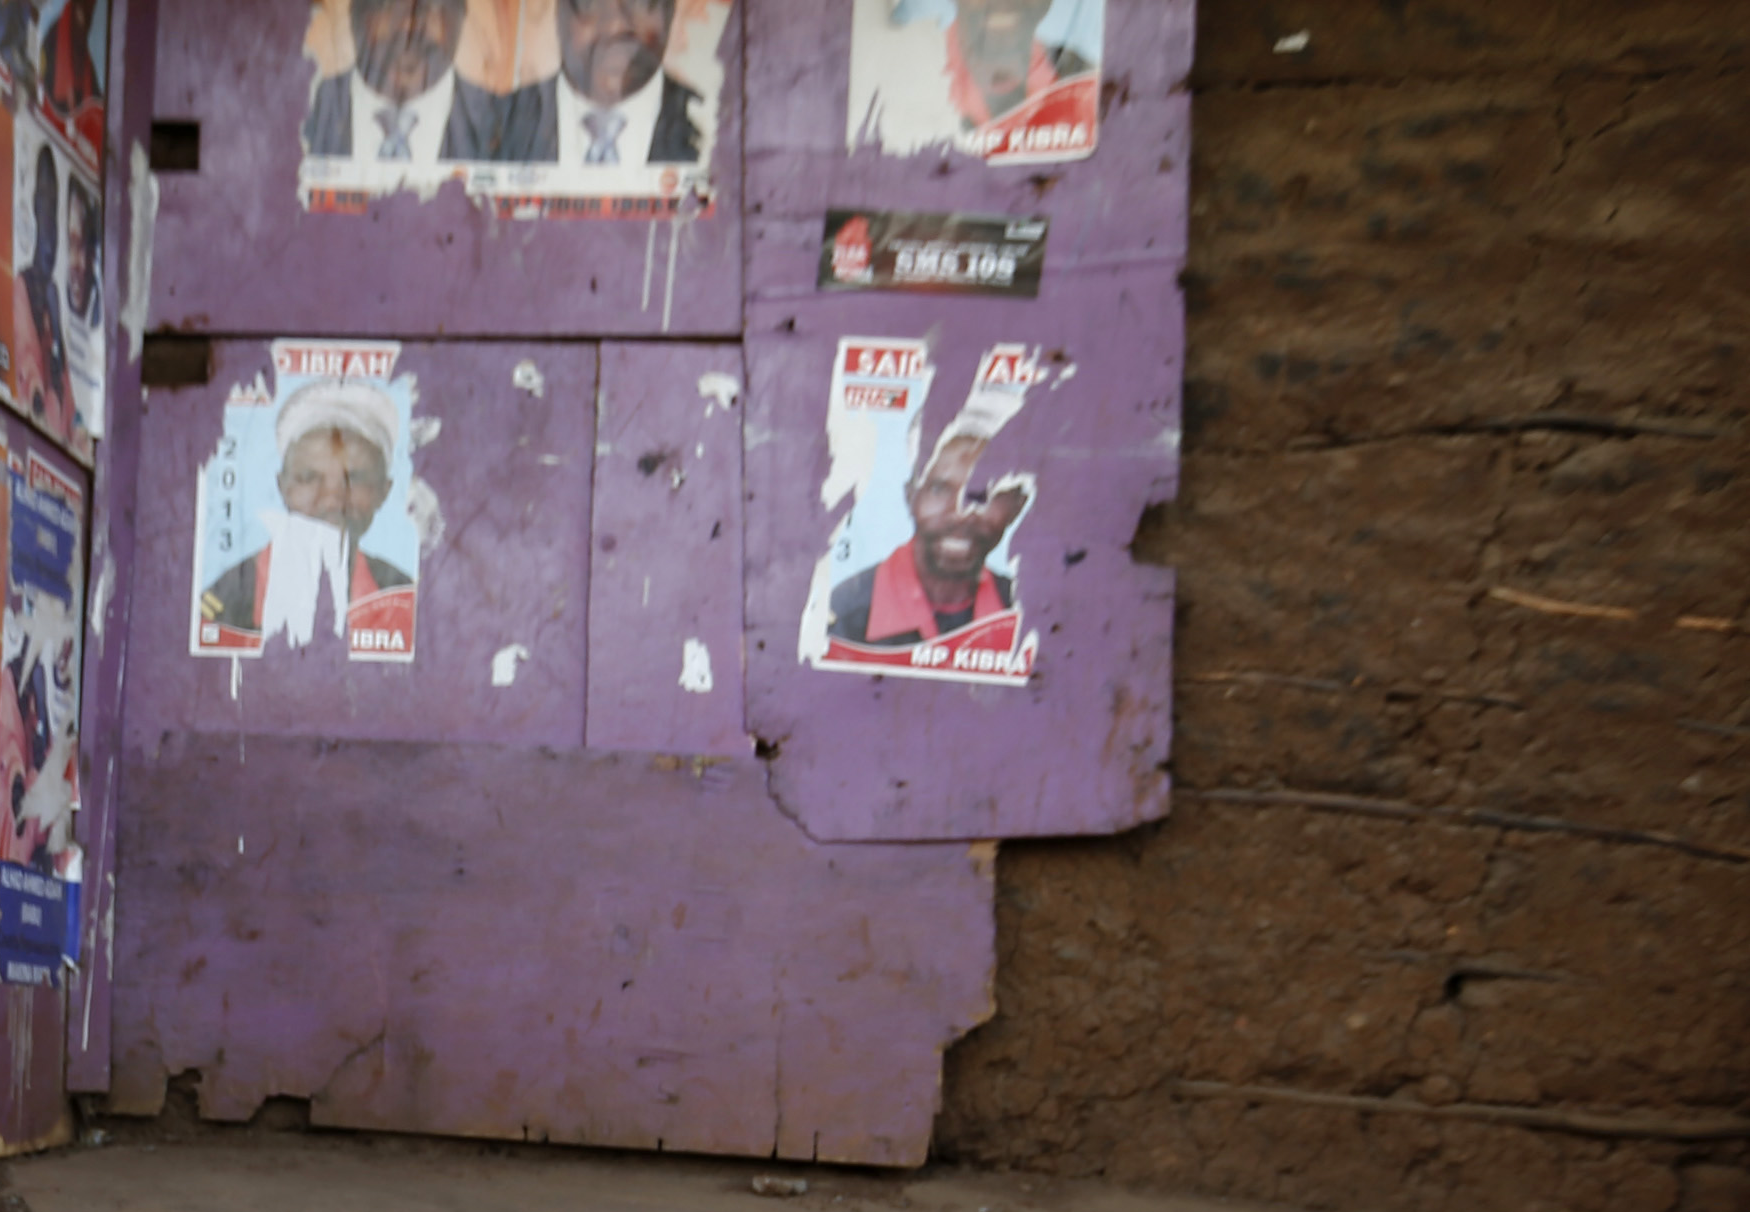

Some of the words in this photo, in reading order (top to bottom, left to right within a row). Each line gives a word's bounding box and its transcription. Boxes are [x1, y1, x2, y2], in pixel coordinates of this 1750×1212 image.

[1008, 121, 1087, 153] KIBRA
[208, 437, 238, 551] 2013
[910, 645, 950, 668] MP
[953, 647, 1029, 675] KIBRA
